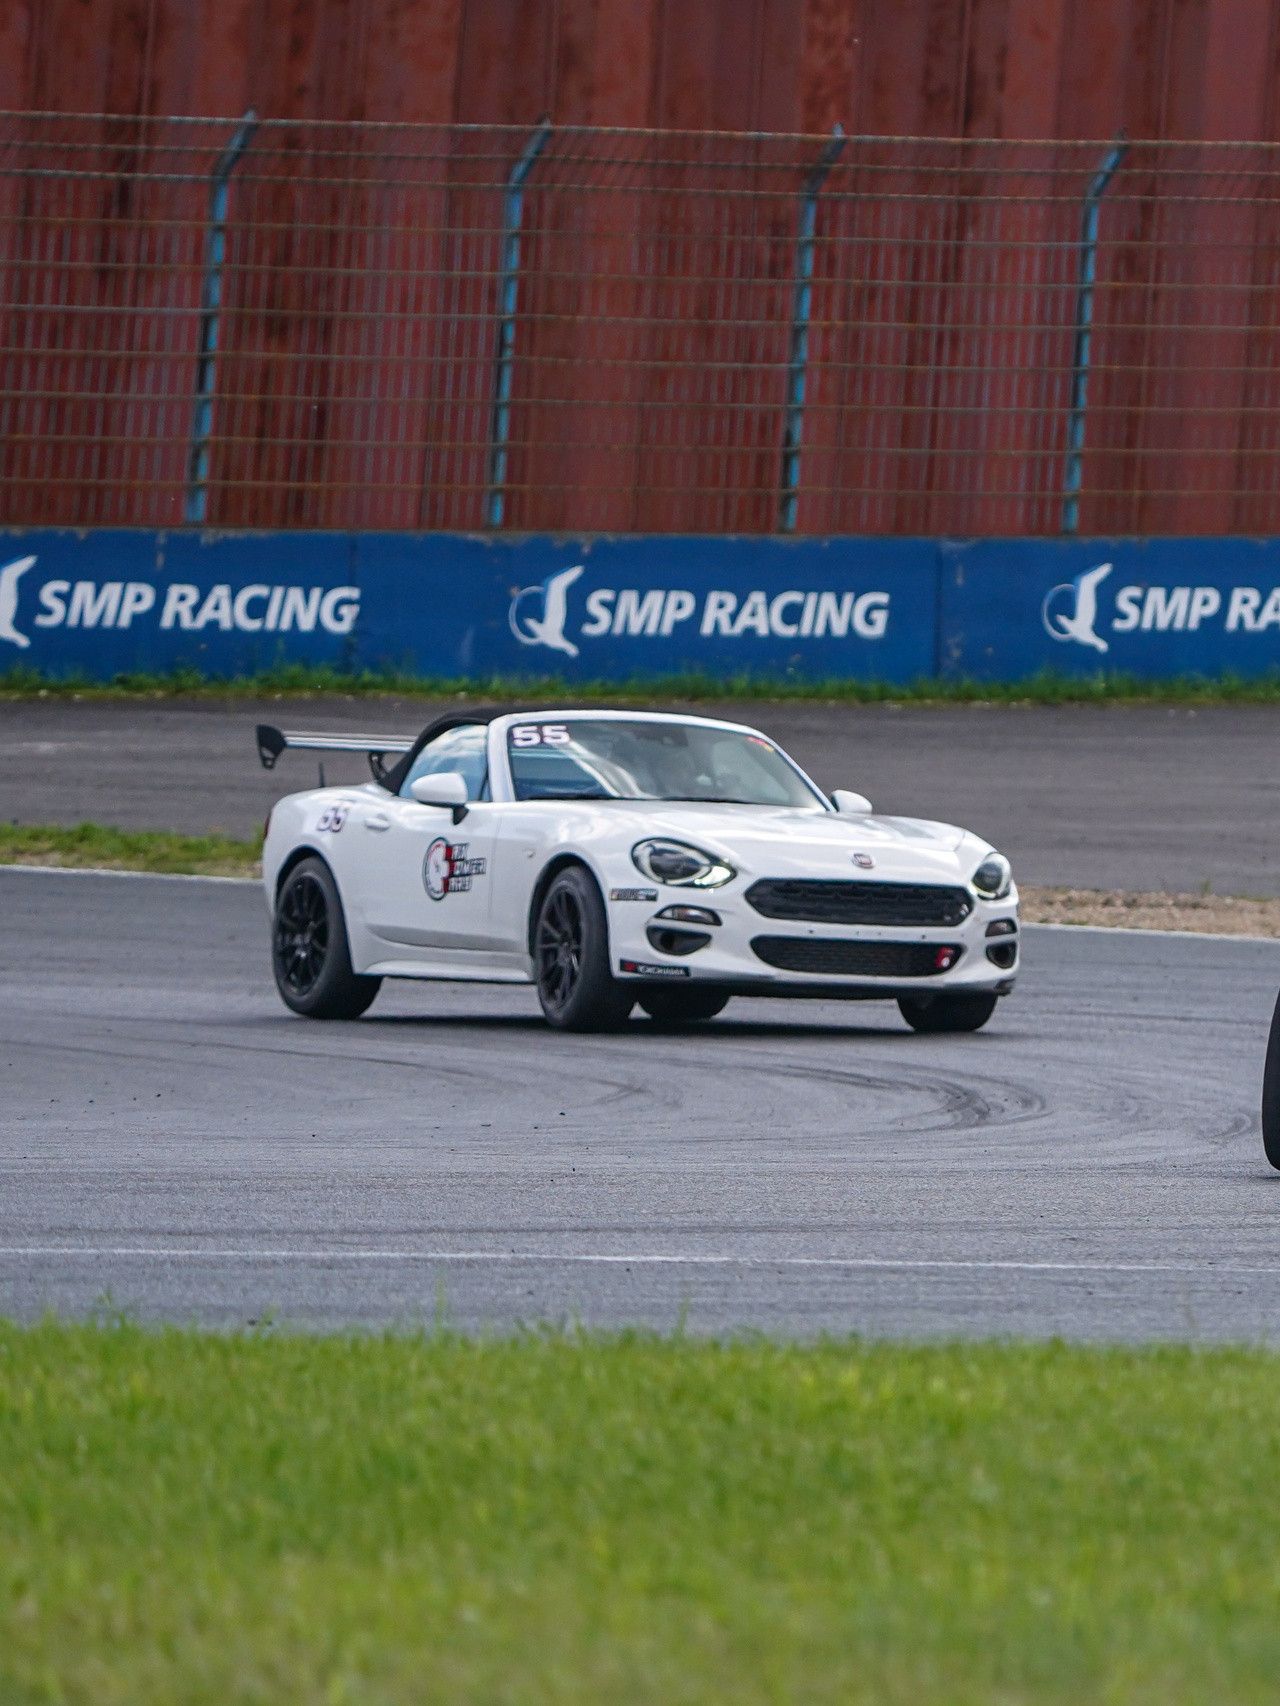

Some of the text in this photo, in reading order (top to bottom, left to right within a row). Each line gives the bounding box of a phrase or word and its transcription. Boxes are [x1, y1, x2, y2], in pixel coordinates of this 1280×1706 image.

[35, 580, 361, 634] SMP RACING
[582, 589, 890, 638] SMP RACING
[1112, 586, 1221, 631] SMP
[512, 725, 570, 747] 55
